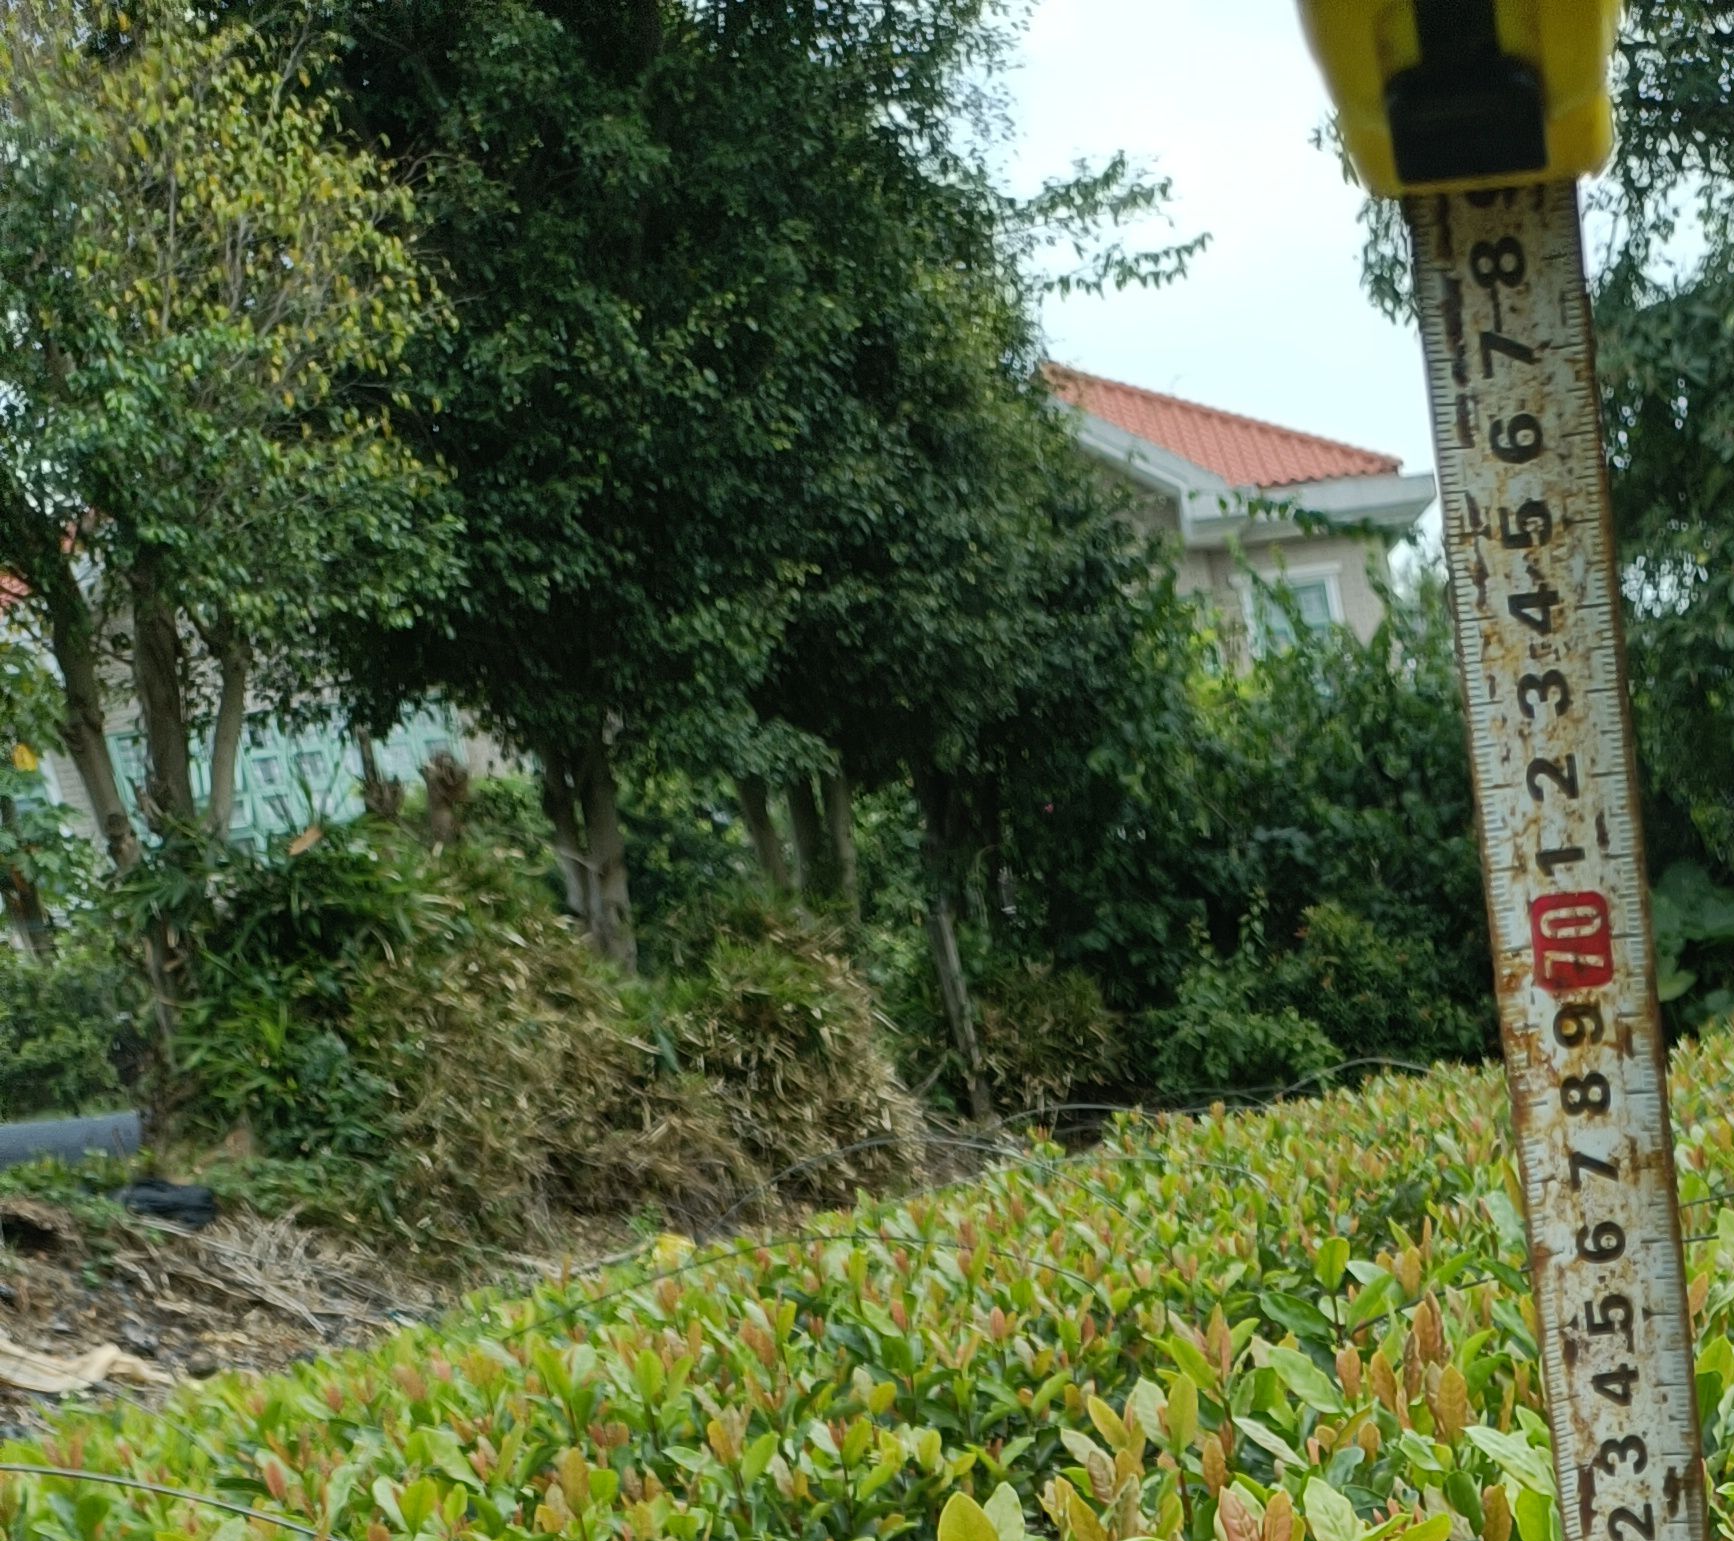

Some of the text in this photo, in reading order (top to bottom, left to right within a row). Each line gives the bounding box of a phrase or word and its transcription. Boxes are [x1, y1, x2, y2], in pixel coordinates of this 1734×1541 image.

[1469, 236, 1526, 289] 8
[1480, 330, 1543, 380] 7
[1489, 412, 1544, 465] 6
[1499, 499, 1553, 549] 5
[1507, 583, 1559, 635] 4
[1517, 668, 1571, 720] 3
[1526, 753, 1579, 802] 2
[1534, 845, 1586, 877] 1
[1539, 905, 1605, 980] 70
[1553, 1002, 1605, 1049] 9
[1560, 1071, 1611, 1117] 8
[1569, 1151, 1619, 1191] 7
[1575, 1220, 1627, 1264] 6
[1584, 1294, 1635, 1337] 5
[1591, 1362, 1639, 1407] 4
[1601, 1434, 1648, 1478] 3
